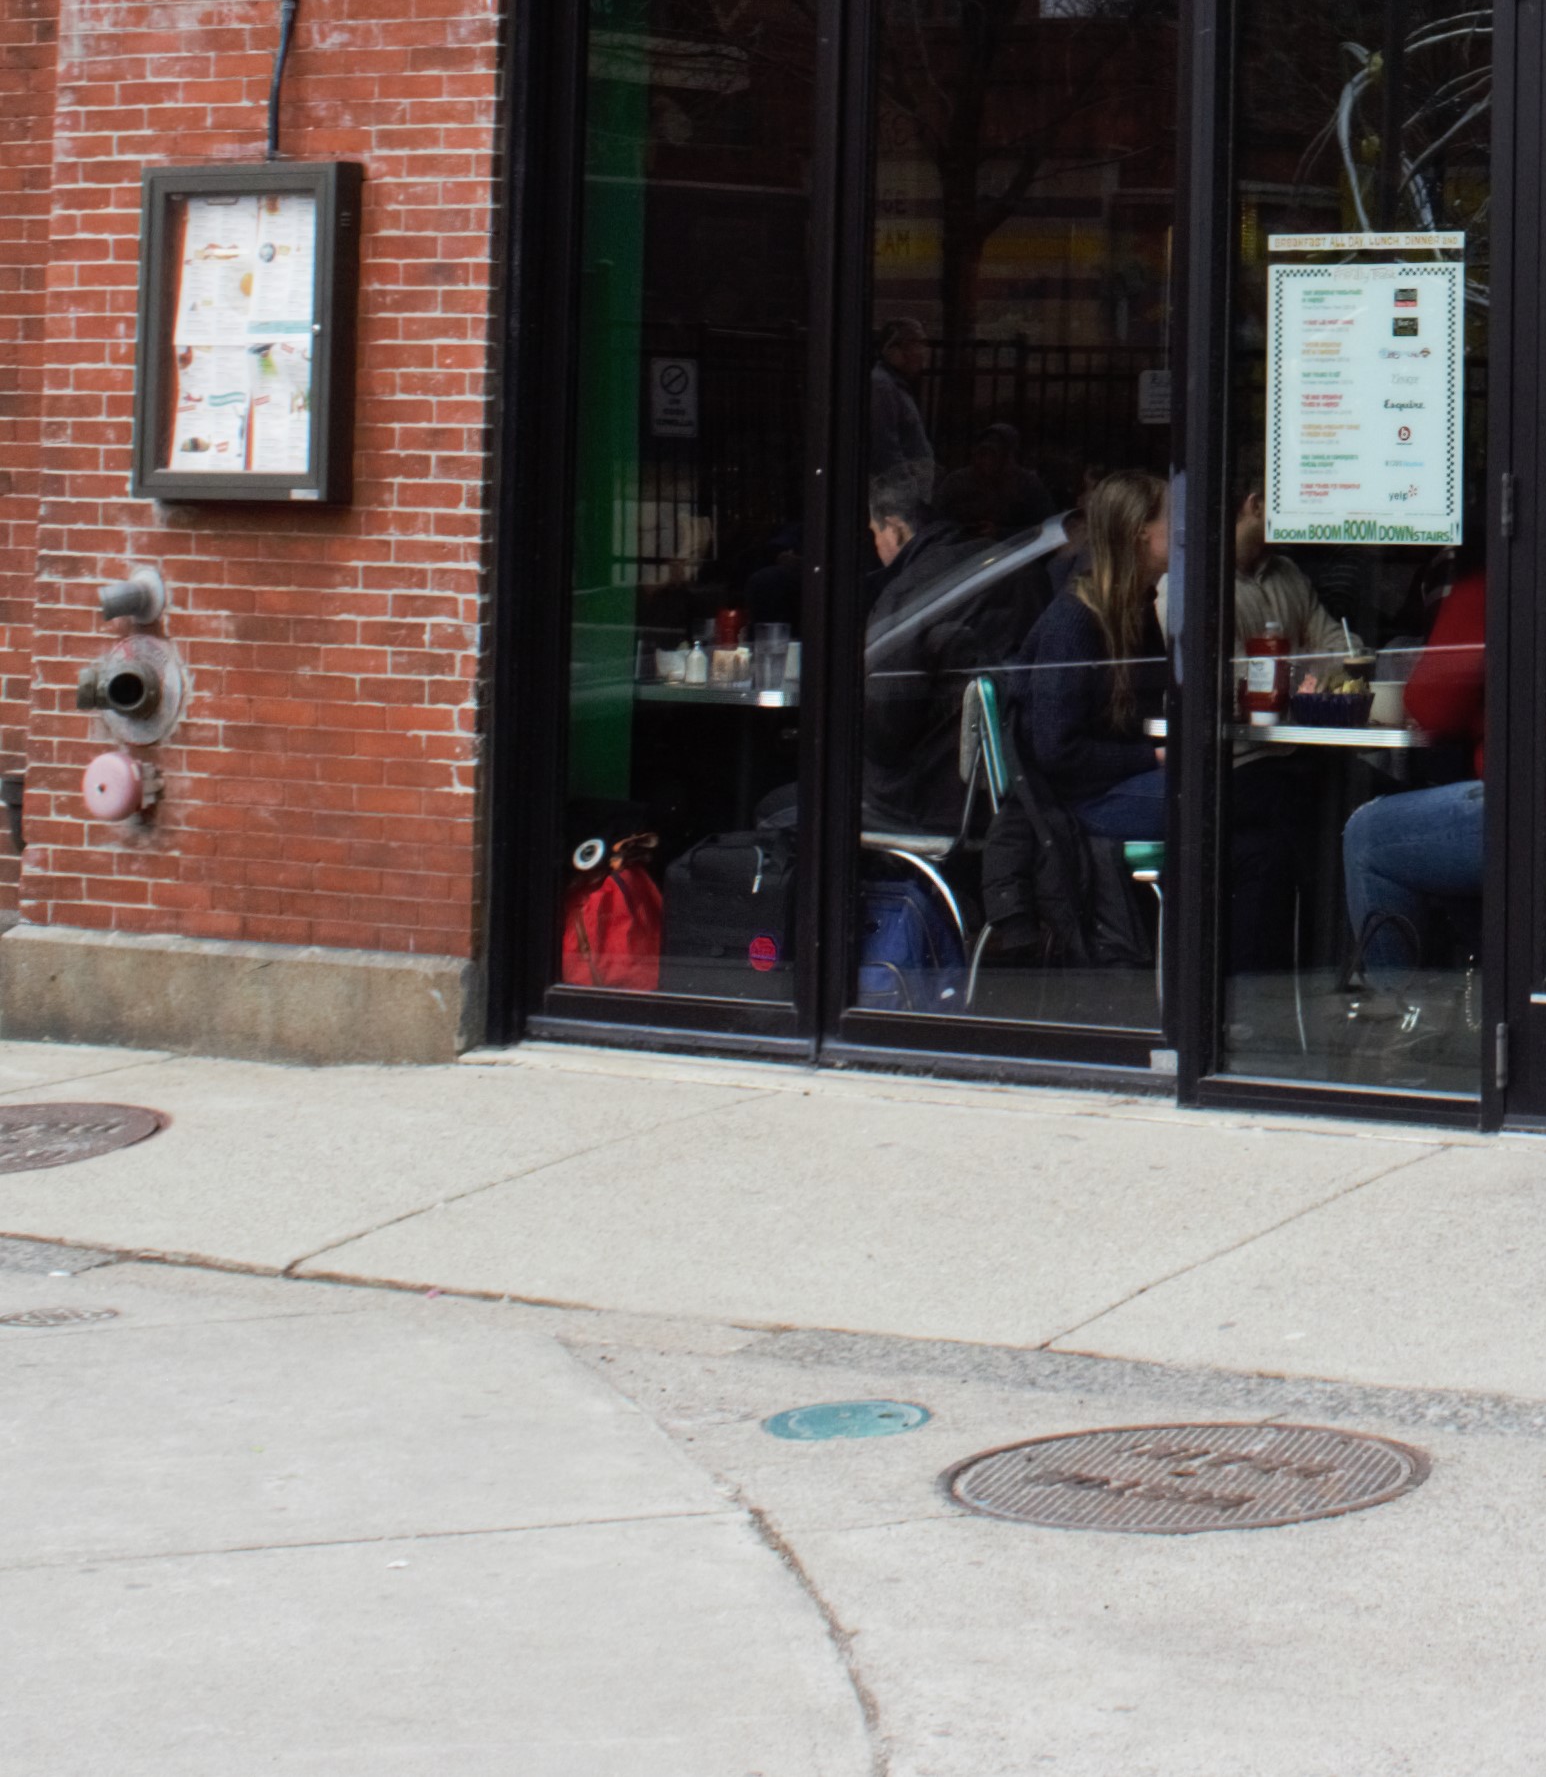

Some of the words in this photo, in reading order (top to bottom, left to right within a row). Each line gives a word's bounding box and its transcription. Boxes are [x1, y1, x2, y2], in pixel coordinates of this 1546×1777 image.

[1273, 528, 1307, 540] BOOM
[1308, 523, 1342, 540] BOOM
[1343, 519, 1377, 540] ROOM
